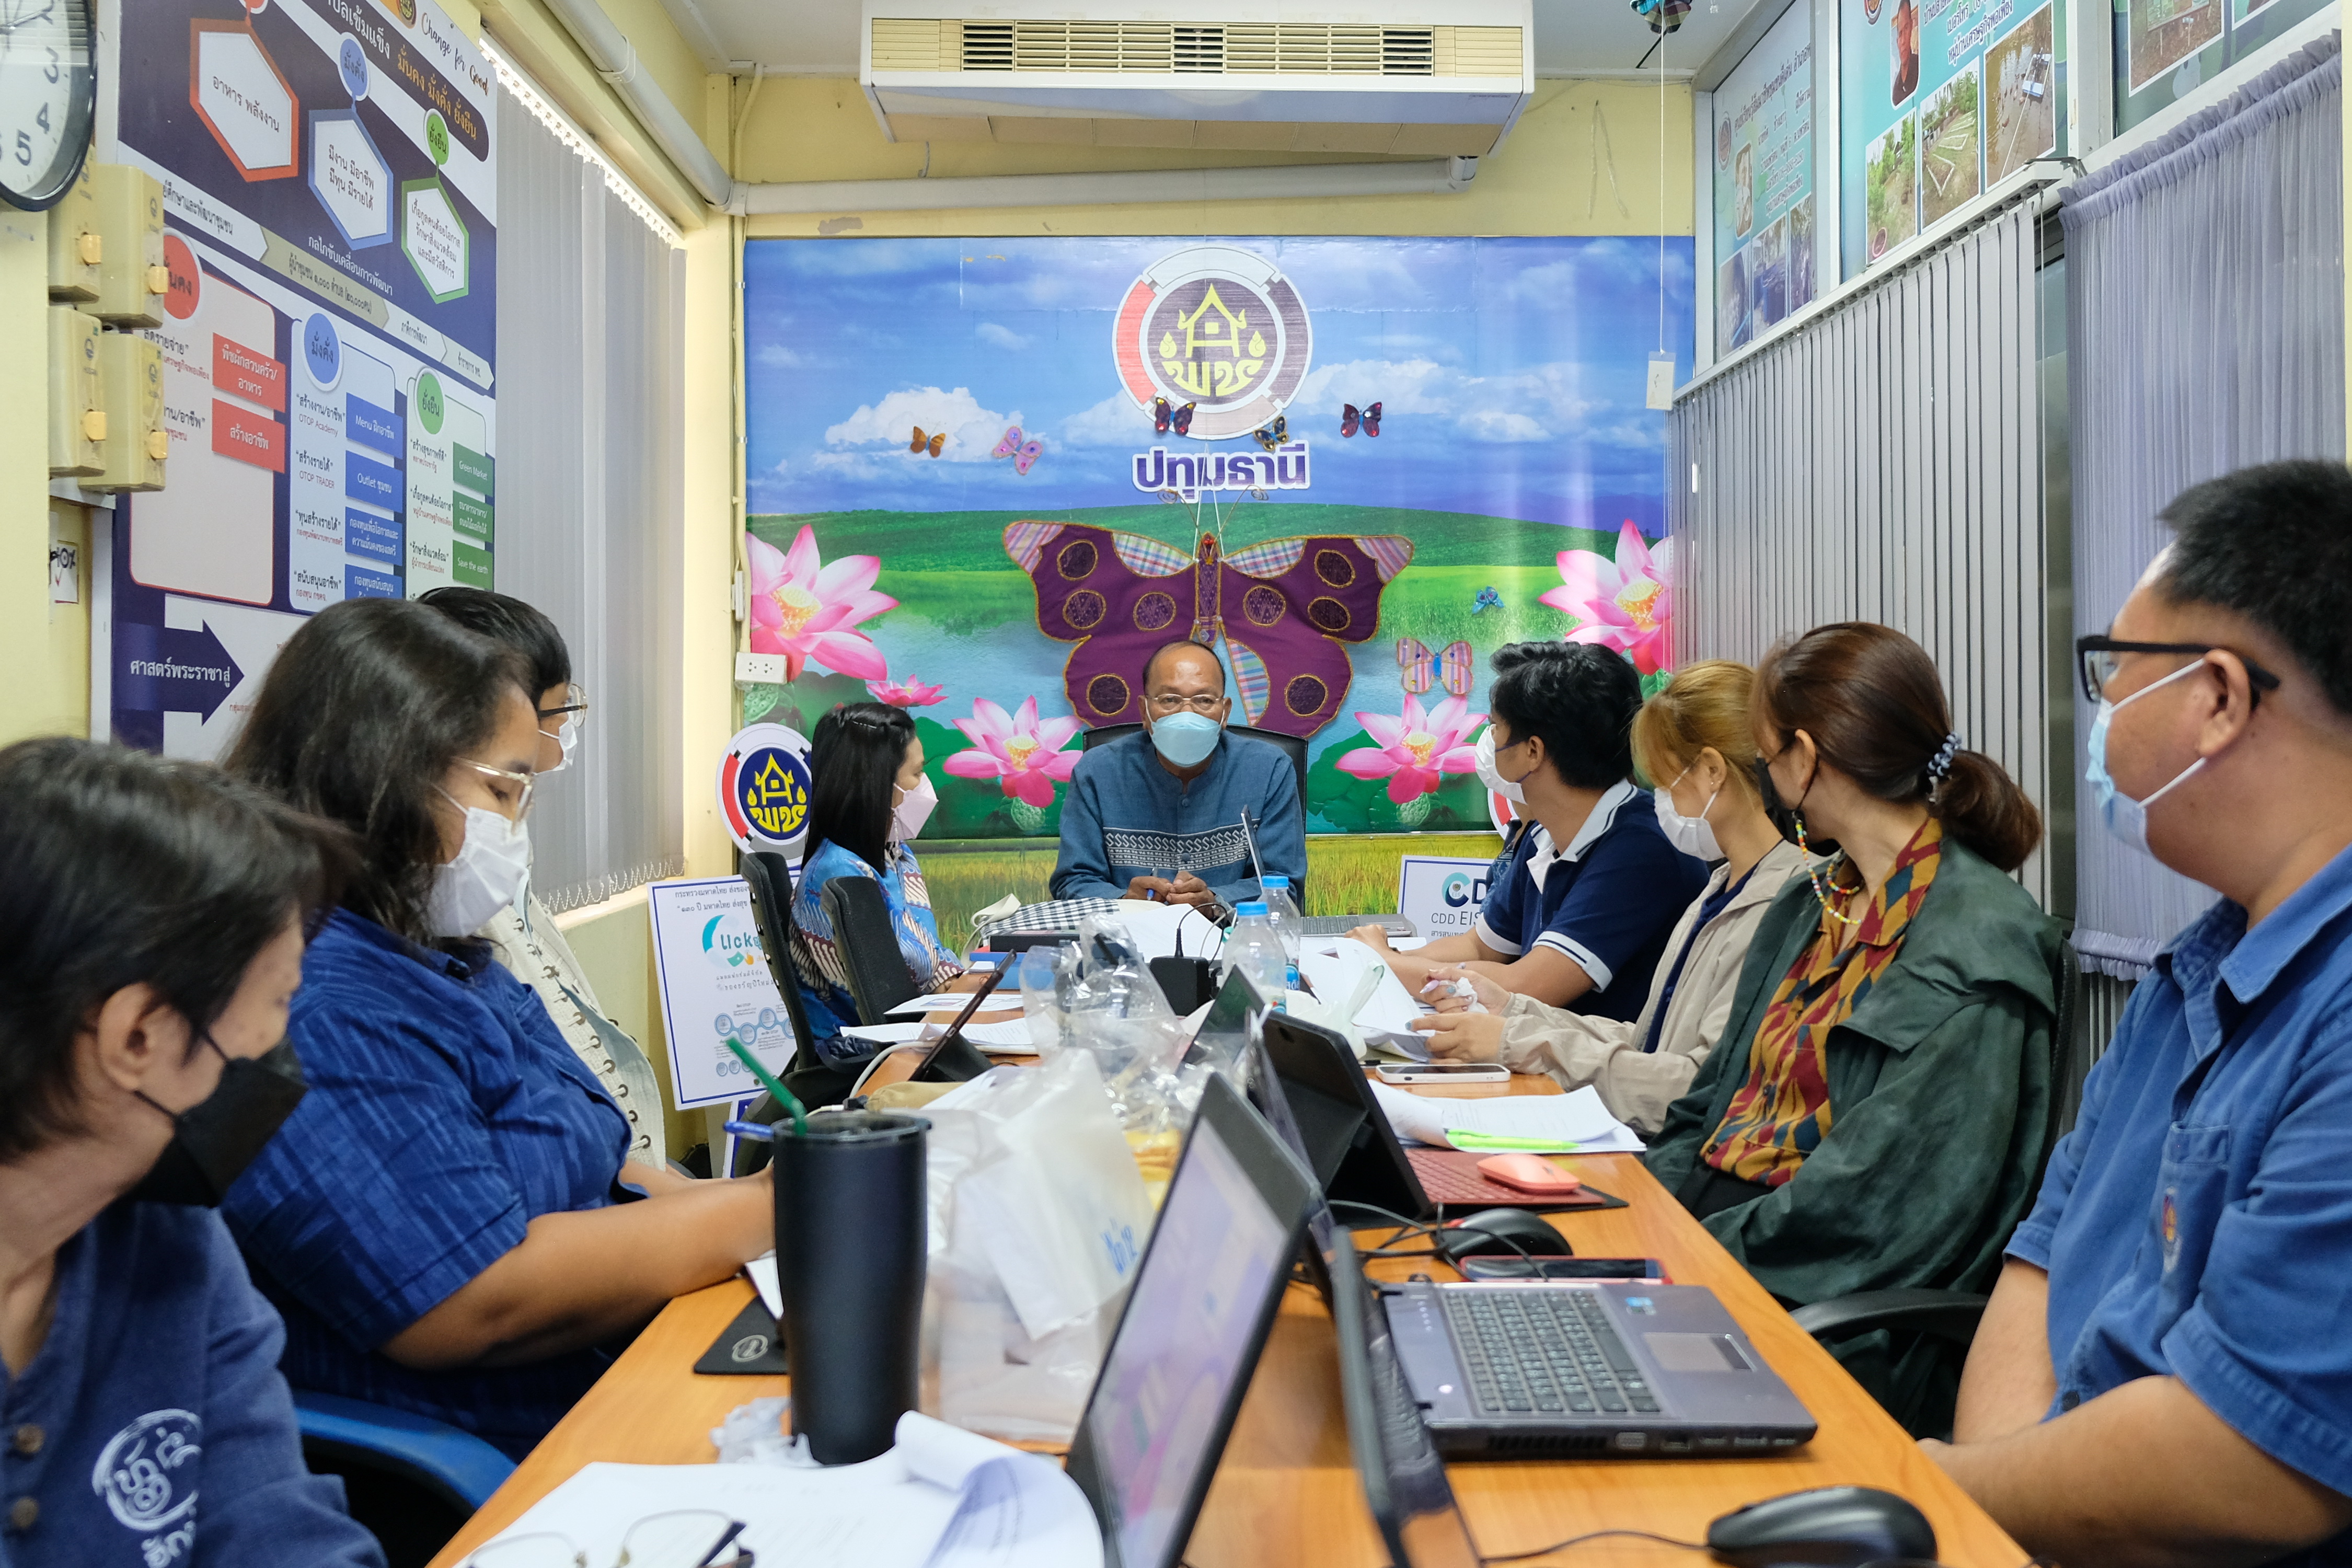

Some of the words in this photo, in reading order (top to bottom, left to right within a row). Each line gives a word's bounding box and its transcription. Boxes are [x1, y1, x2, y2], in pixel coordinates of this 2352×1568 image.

[43, 47, 59, 84] 3
[328, 0, 390, 60] บลเข้มแข็ง
[397, 44, 425, 91] มั่นคง
[428, 74, 451, 116] มั่งคั่ง
[454, 98, 477, 140] ยั่งยืน
[343, 49, 365, 84] มั่งคั่ง
[421, 13, 452, 57] Change
[454, 48, 466, 72] for
[469, 65, 489, 96] Good
[36, 102, 50, 134] 4
[213, 76, 242, 108] อาหาร
[246, 100, 280, 133] พลังงาน
[15, 129, 31, 166] 5
[429, 123, 447, 155] ยั่งยืน
[328, 144, 348, 171] มีงาน
[350, 160, 375, 191] มีอาชีพ
[329, 167, 345, 193] มีทุน
[348, 181, 373, 211] มีรายได้
[411, 198, 461, 248] เกื้อกูลคนด้อยโอกาส
[416, 223, 457, 262] รักษาสิ่งแวดล้อม
[308, 236, 393, 296] กลไกขับเคลื่อนการพัฒนา
[418, 246, 455, 279] และมีสวัสดิการ
[222, 344, 278, 381] พืชผักสวนครัว/
[311, 331, 333, 364] มั่งคั่ง
[238, 378, 262, 396] อาหาร
[422, 389, 440, 417] ยั่งยืน
[230, 423, 269, 449] สร้างอาชีพ
[299, 413, 314, 426] OTOP
[315, 420, 338, 437] Academy
[355, 415, 372, 430] Menu
[299, 470, 315, 482] OTOP
[316, 476, 335, 489] TRADER
[357, 473, 376, 488] Outlet
[377, 480, 391, 493] ชุมชน
[459, 460, 472, 474] Green
[473, 466, 488, 480] Market
[1137, 443, 1306, 500] ปทุมธานี
[457, 557, 468, 568] Save
[477, 564, 488, 574] earth
[131, 656, 230, 688] ศาสตร์พระราชาสู่
[675, 886, 727, 898] กระทรวงมหาดไทย
[697, 902, 701, 910] ปี
[704, 900, 730, 910] มหาดไทย
[733, 899, 747, 909] ส่งสุข
[1431, 913, 1455, 925] CDD
